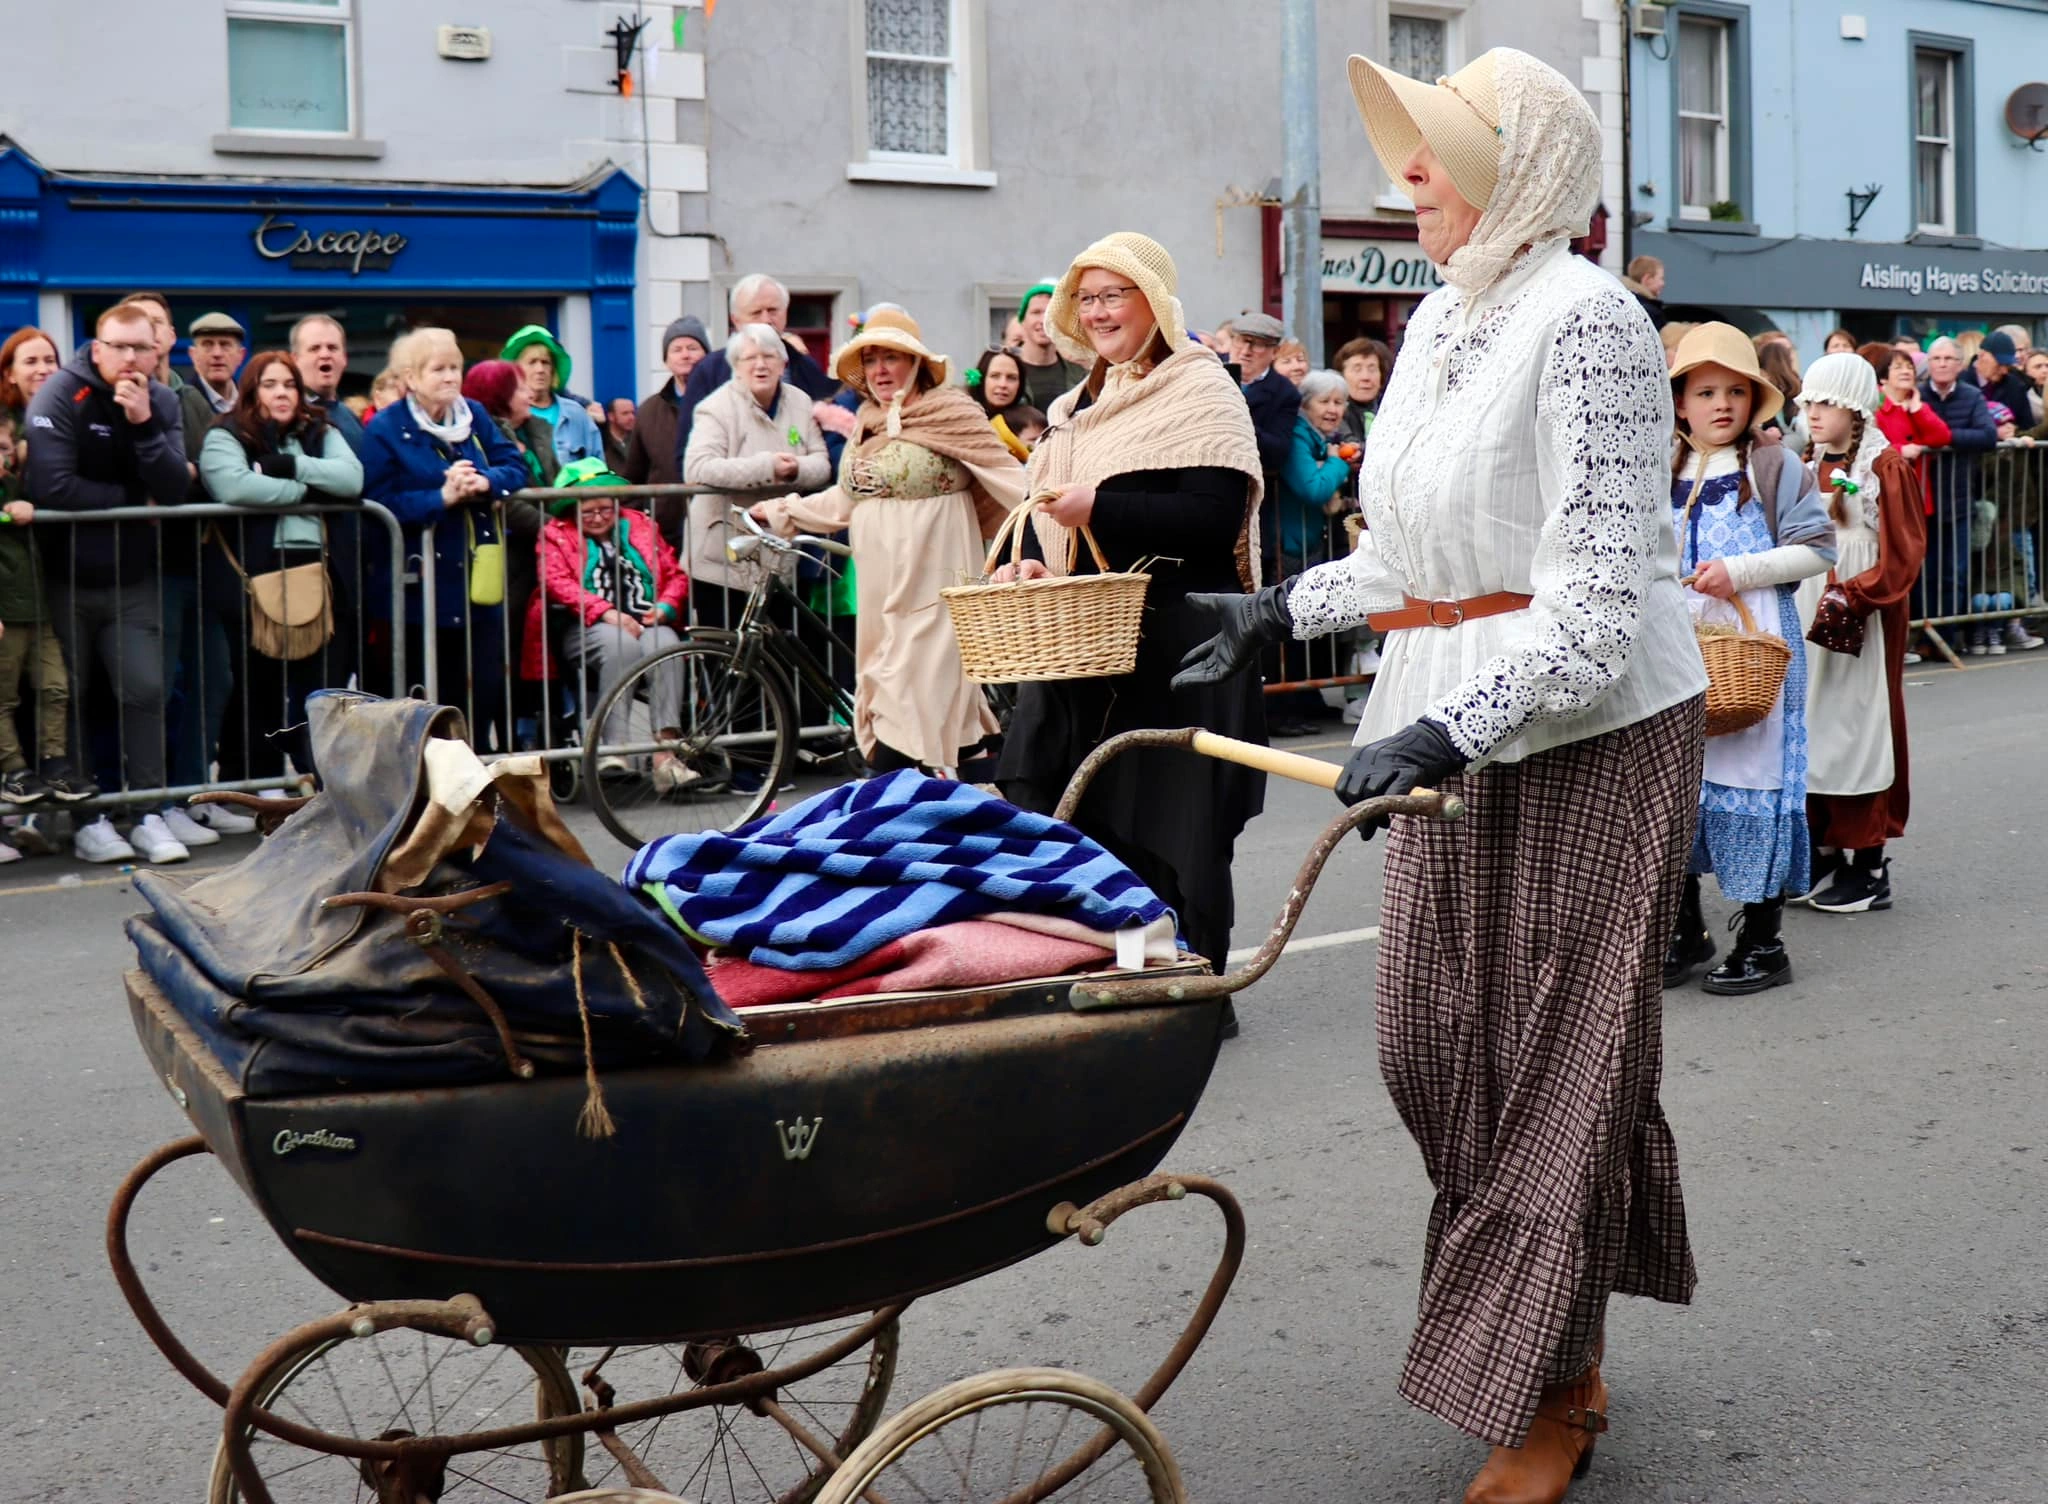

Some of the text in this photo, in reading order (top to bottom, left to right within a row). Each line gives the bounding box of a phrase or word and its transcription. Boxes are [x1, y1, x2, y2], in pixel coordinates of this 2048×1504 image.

[255, 213, 408, 275] Escape
[1860, 262, 1923, 295] Aisling
[1925, 265, 1980, 296] Hayes
